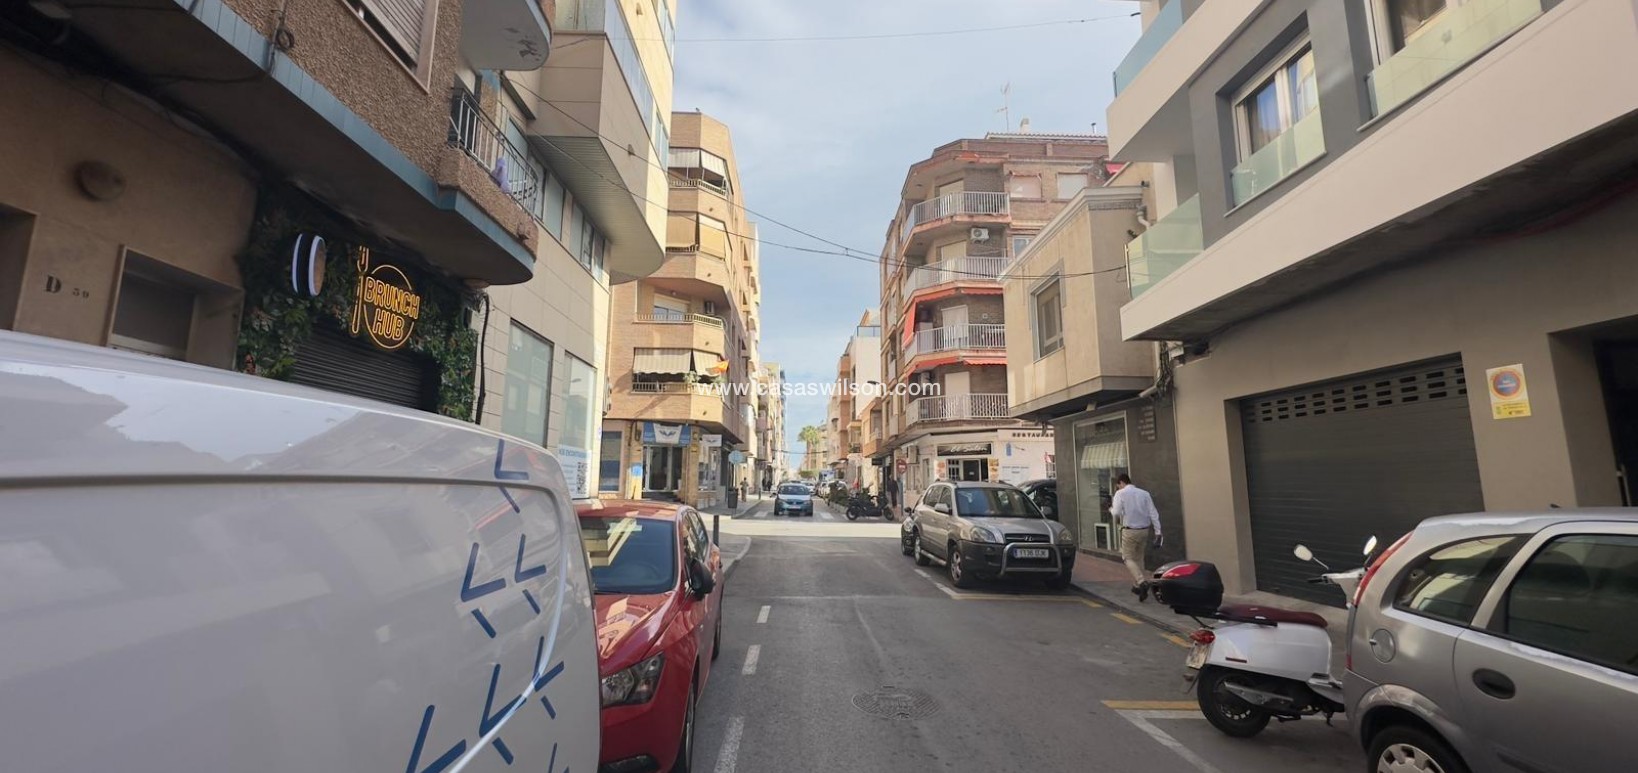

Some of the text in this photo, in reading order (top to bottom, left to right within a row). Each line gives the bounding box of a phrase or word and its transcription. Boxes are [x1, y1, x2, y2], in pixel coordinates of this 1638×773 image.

[45, 275, 62, 293] D
[364, 276, 420, 319] BRUNCH
[372, 308, 404, 340] HUB
